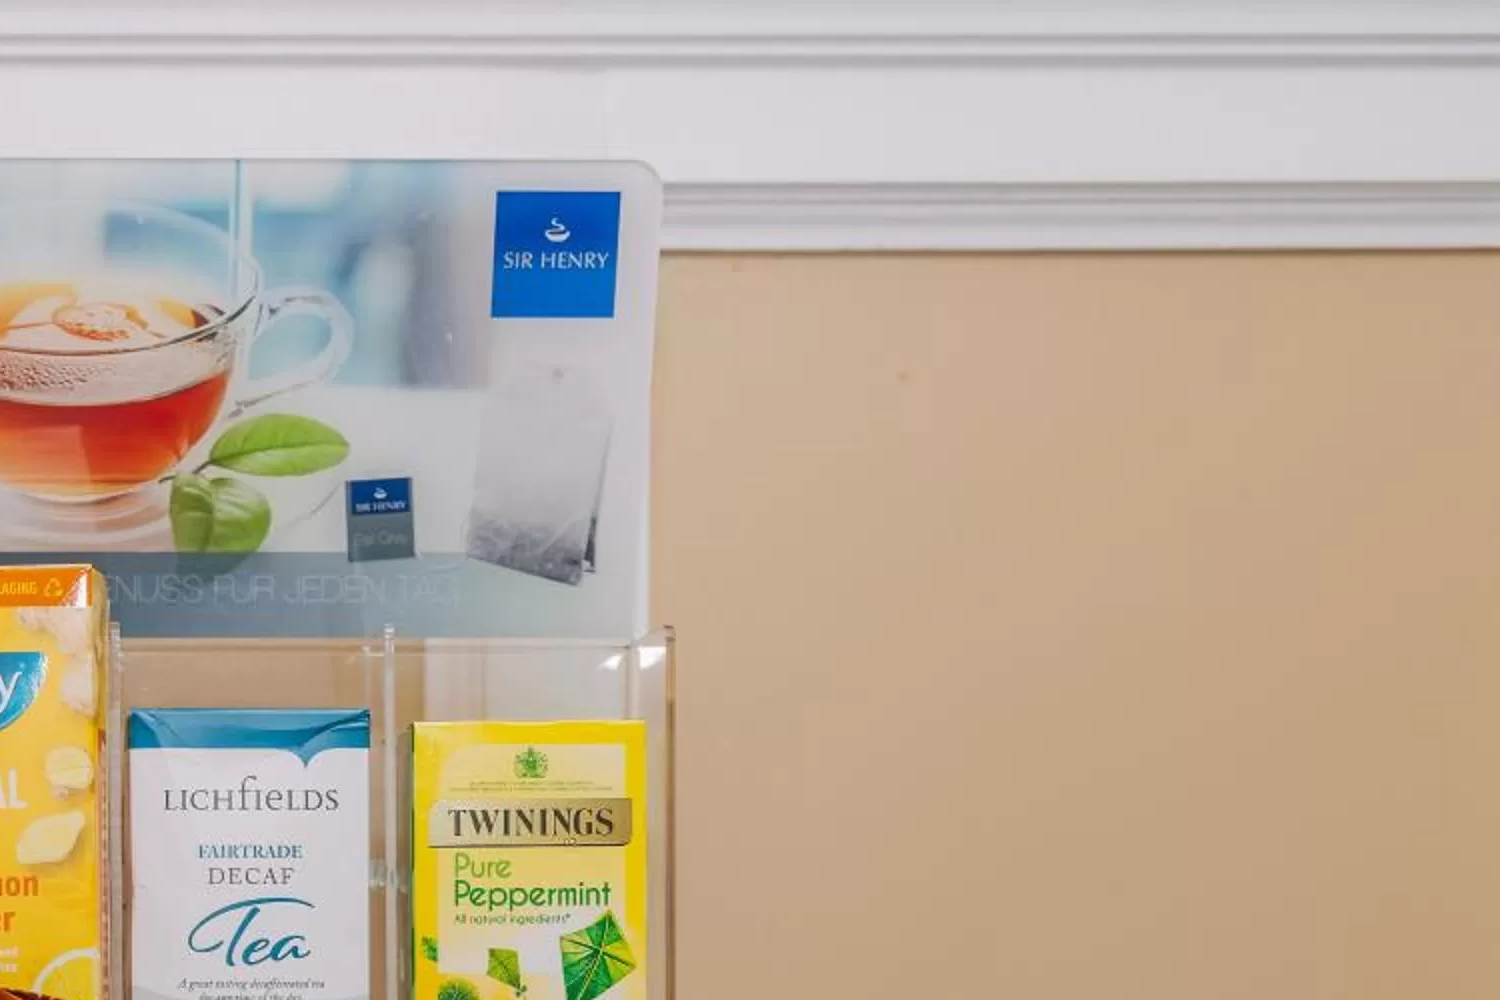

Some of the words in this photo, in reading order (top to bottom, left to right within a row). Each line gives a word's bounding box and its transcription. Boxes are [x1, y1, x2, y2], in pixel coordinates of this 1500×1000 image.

[503, 251, 533, 269] SIR
[541, 251, 609, 269] HENRY
[448, 807, 614, 837] TWININGS
[198, 844, 304, 860] FAIRTRADE
[455, 852, 512, 878] Pure
[208, 867, 296, 886] DECAF
[455, 879, 612, 912] Peppermint
[187, 897, 316, 968] Tea
